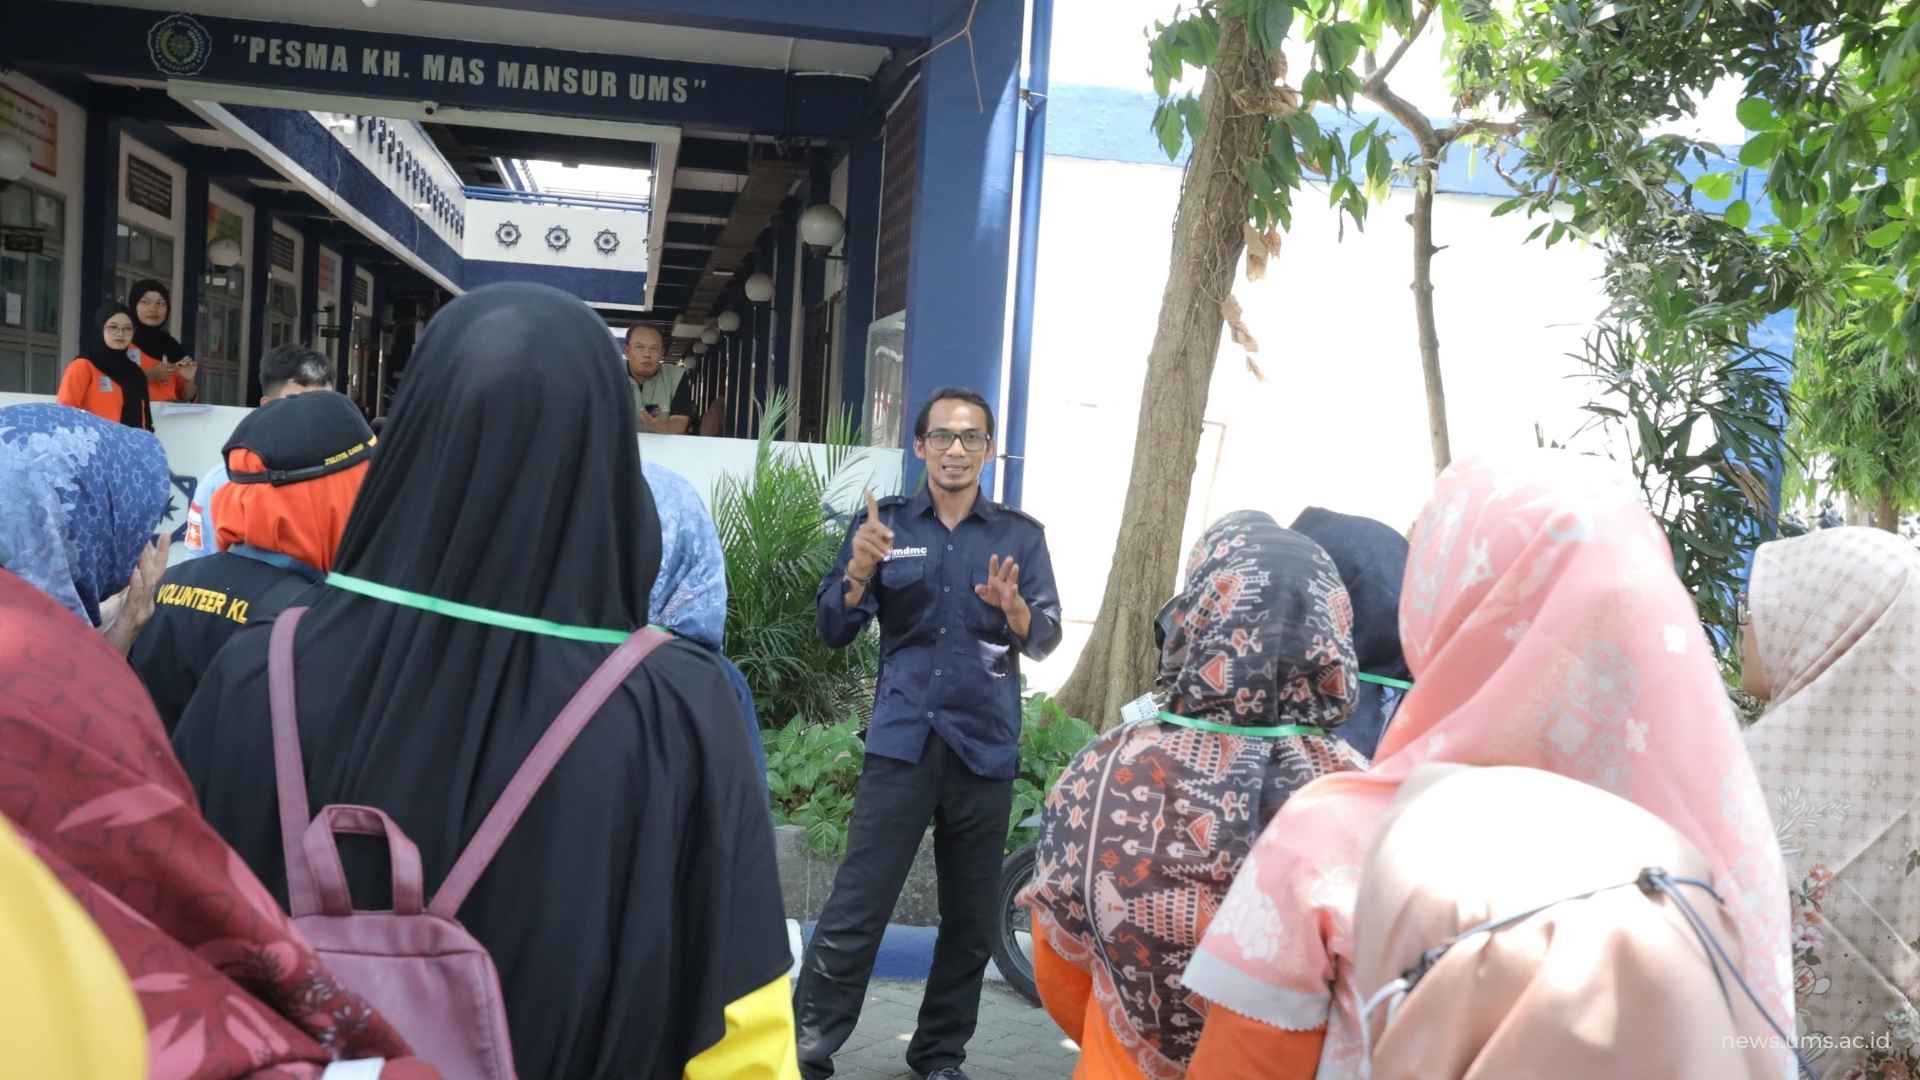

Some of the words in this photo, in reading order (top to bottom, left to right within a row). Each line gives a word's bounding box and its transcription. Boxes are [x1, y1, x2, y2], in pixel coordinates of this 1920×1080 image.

[361, 47, 410, 79] KH.
[422, 53, 486, 86] MAS
[496, 60, 617, 97] MANSUR
[156, 583, 228, 615] VOLUNTEER
[225, 597, 249, 624] KL
